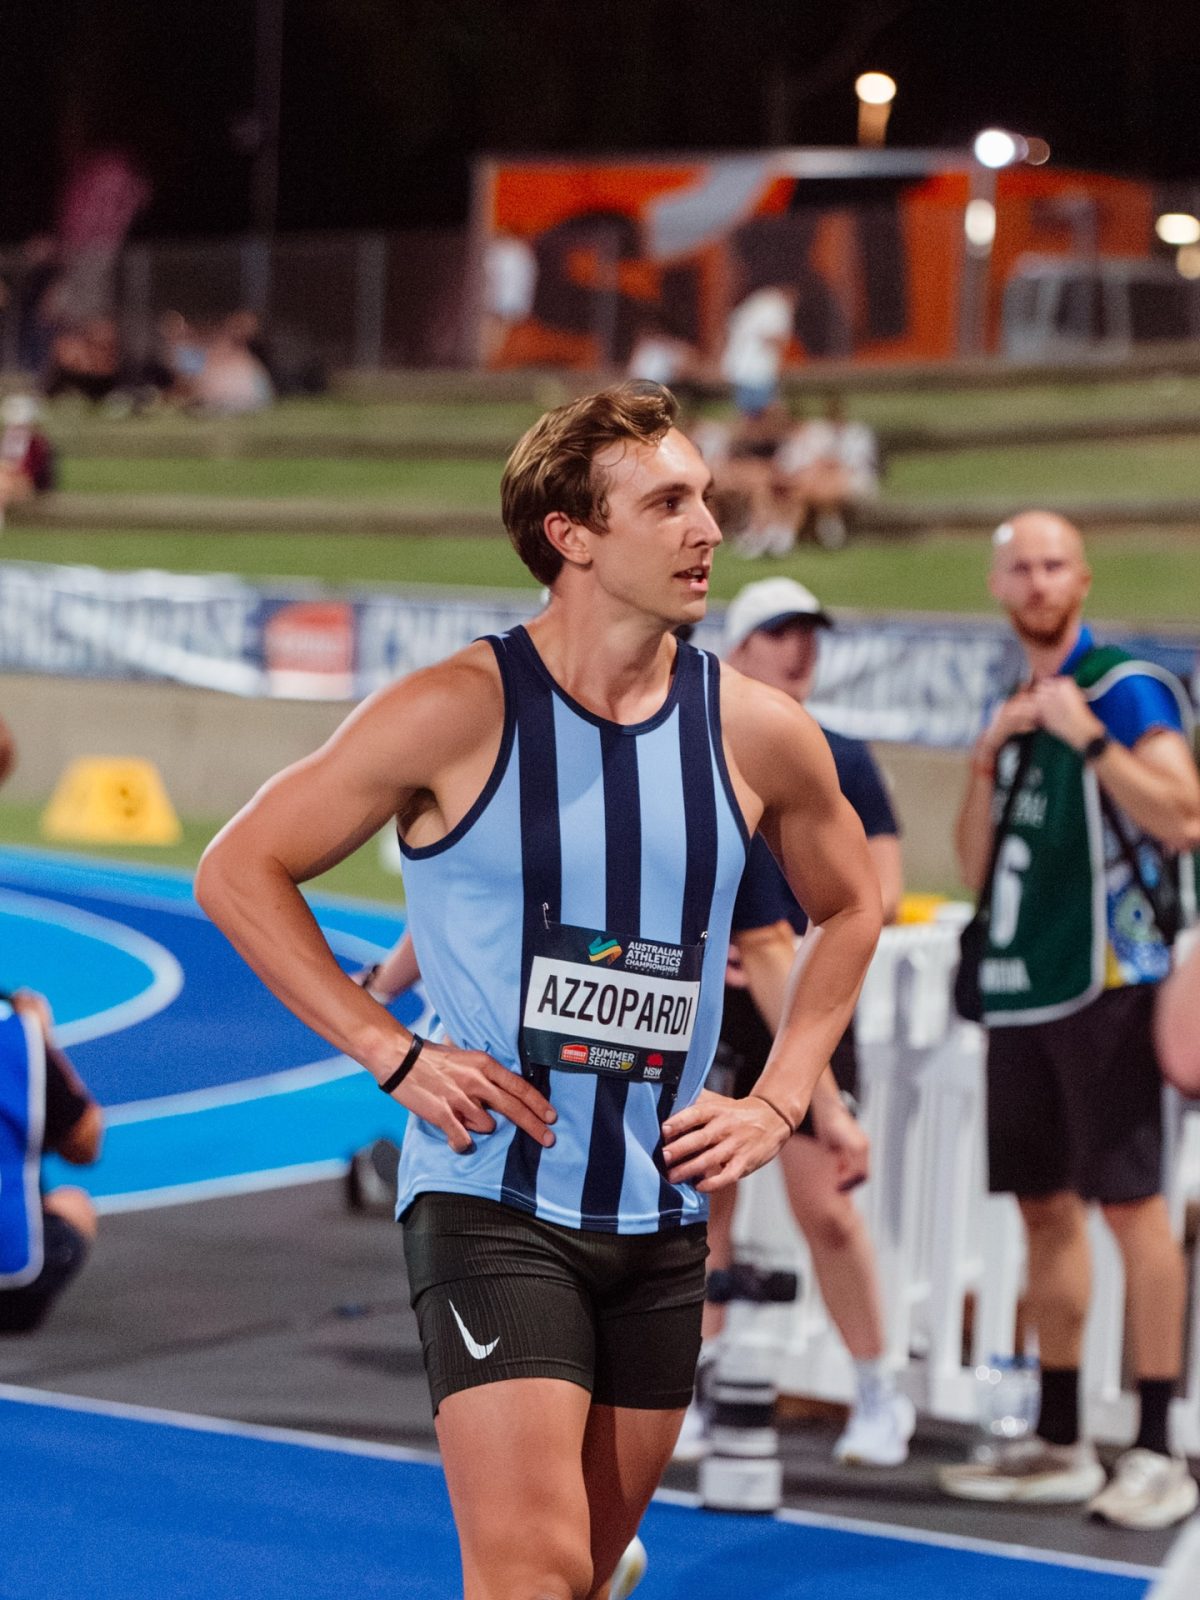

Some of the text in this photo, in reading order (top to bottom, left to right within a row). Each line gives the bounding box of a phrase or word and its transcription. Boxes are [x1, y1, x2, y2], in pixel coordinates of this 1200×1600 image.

[626, 949, 681, 967] ATHLETICS
[627, 941, 683, 958] AUSTRALIAN
[624, 958, 679, 973] CHAMPIONSHIPS
[537, 974, 693, 1036] AZZOPARDI
[588, 1055, 621, 1070] SERIES
[590, 1046, 635, 1063] SUMMER
[643, 1066, 662, 1077] NSW
